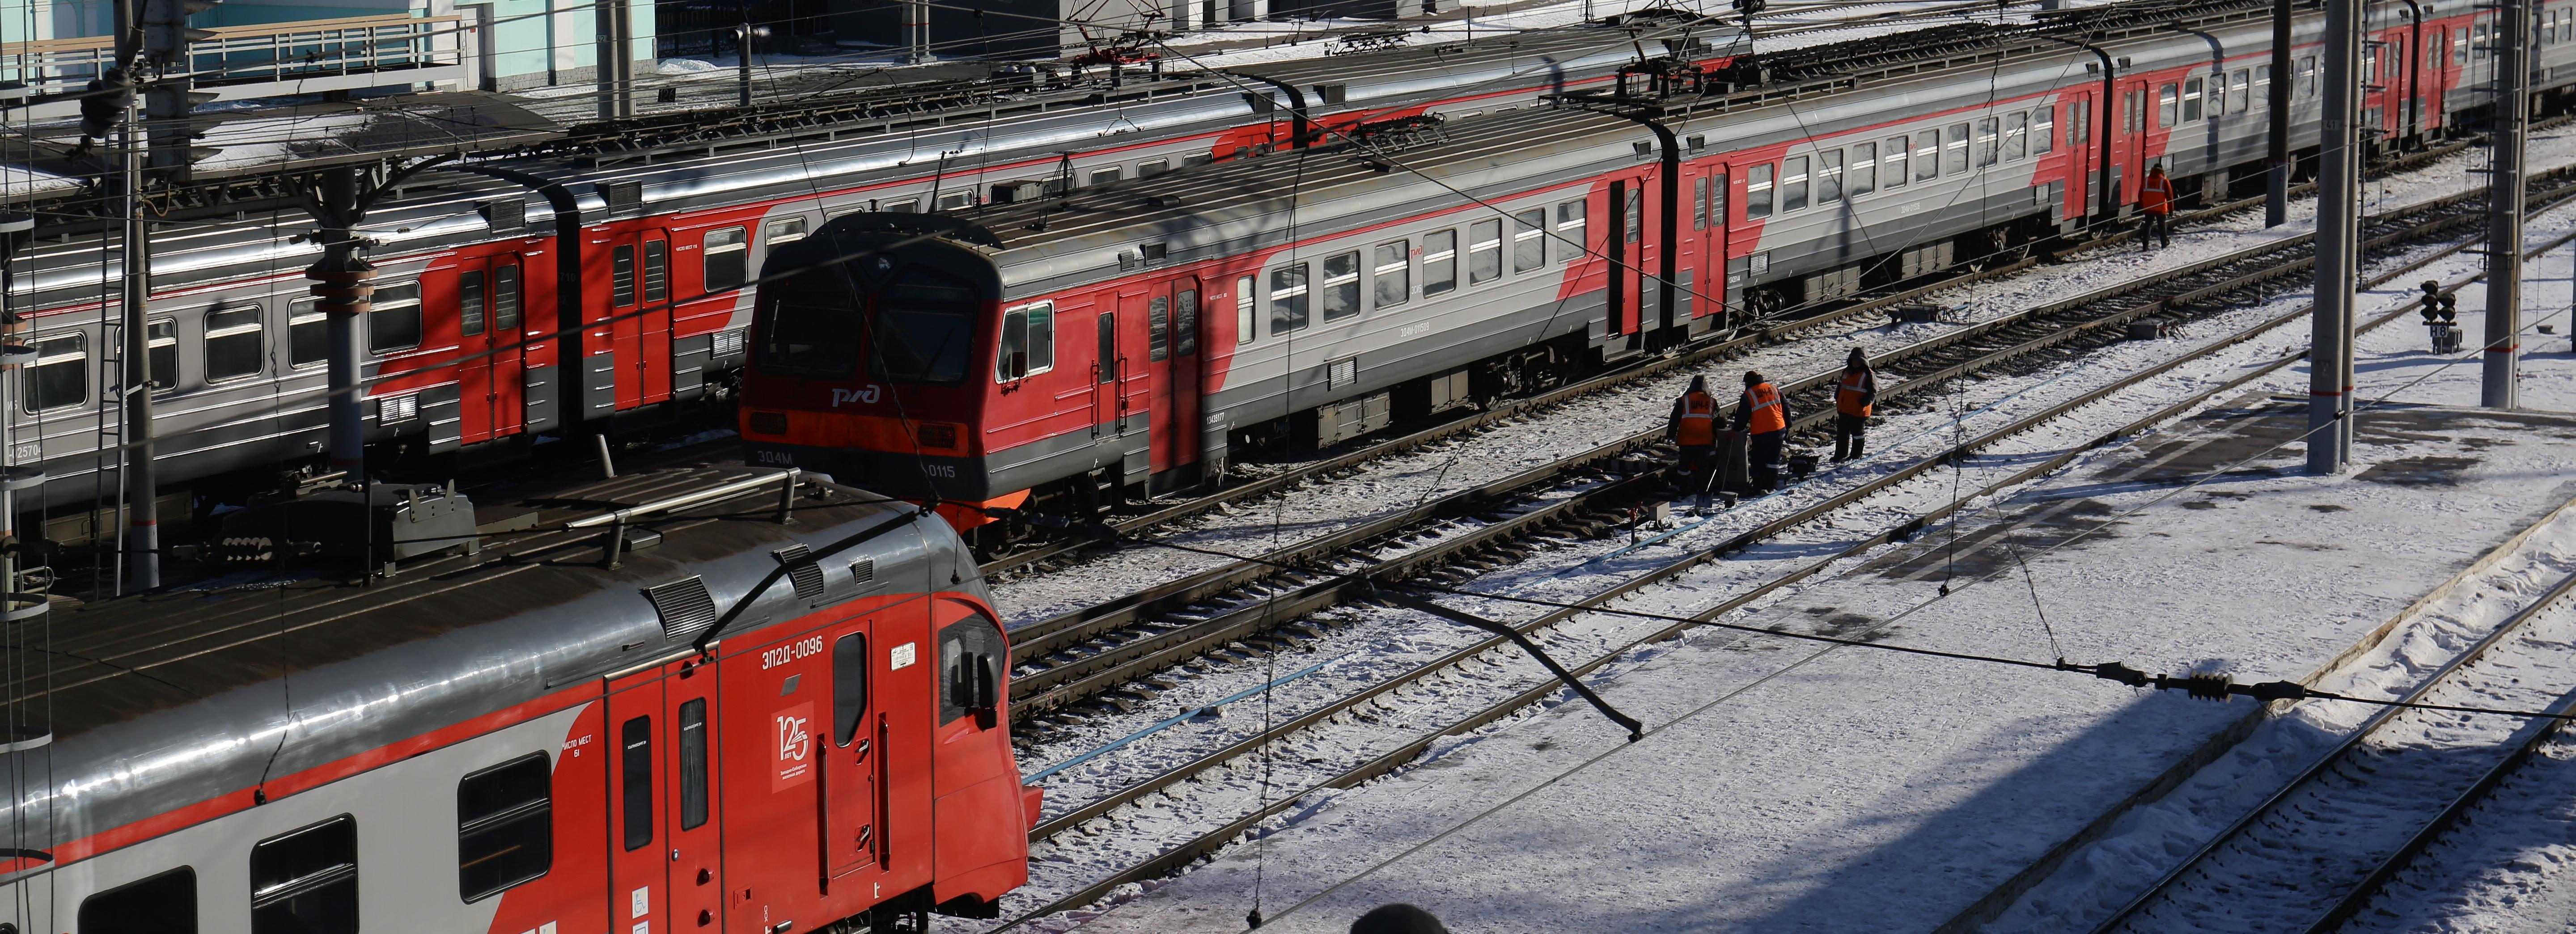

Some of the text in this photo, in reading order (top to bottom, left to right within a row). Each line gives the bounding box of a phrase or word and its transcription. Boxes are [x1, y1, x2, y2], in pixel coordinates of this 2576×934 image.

[2326, 120, 2335, 129] 41
[1411, 284, 1422, 294] ЗСИБ
[1207, 412, 1224, 425] 13435177
[757, 450, 792, 465] ЭД4М
[929, 465, 955, 478] 0115
[762, 635, 822, 670] ЭП2Д-0096
[579, 735, 591, 746] МЕСТ
[777, 716, 809, 761] 125
[574, 749, 580, 757] 61
